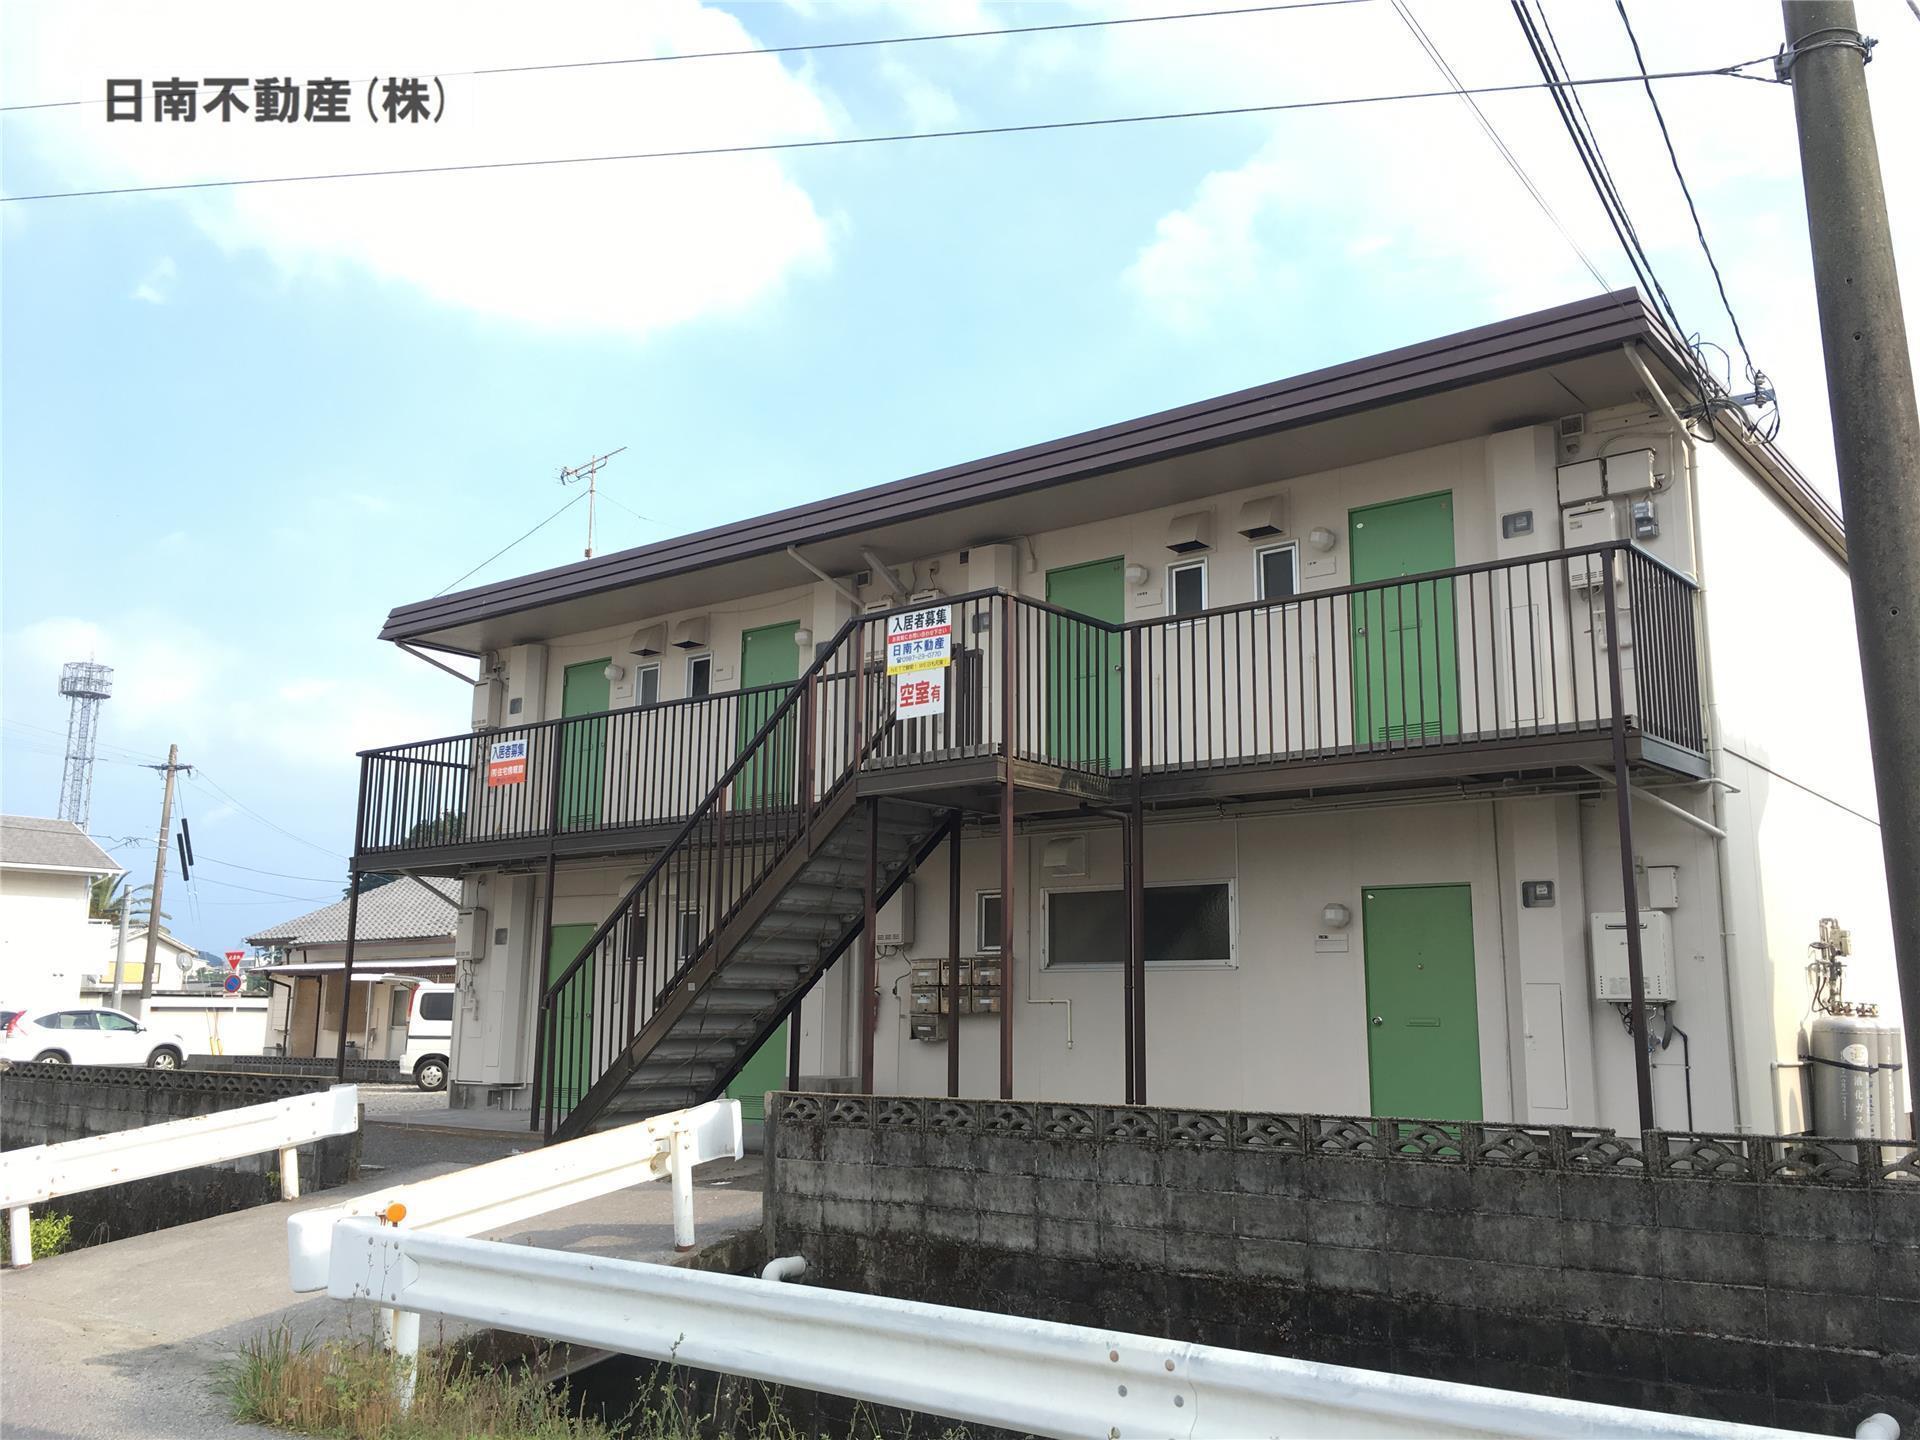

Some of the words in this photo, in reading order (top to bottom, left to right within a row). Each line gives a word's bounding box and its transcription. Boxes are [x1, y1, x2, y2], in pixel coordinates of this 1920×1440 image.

[893, 608, 947, 634] 入居者募集
[893, 637, 945, 657] 日南不動産
[899, 680, 941, 708] 空室有
[492, 743, 525, 760] 入居者募集
